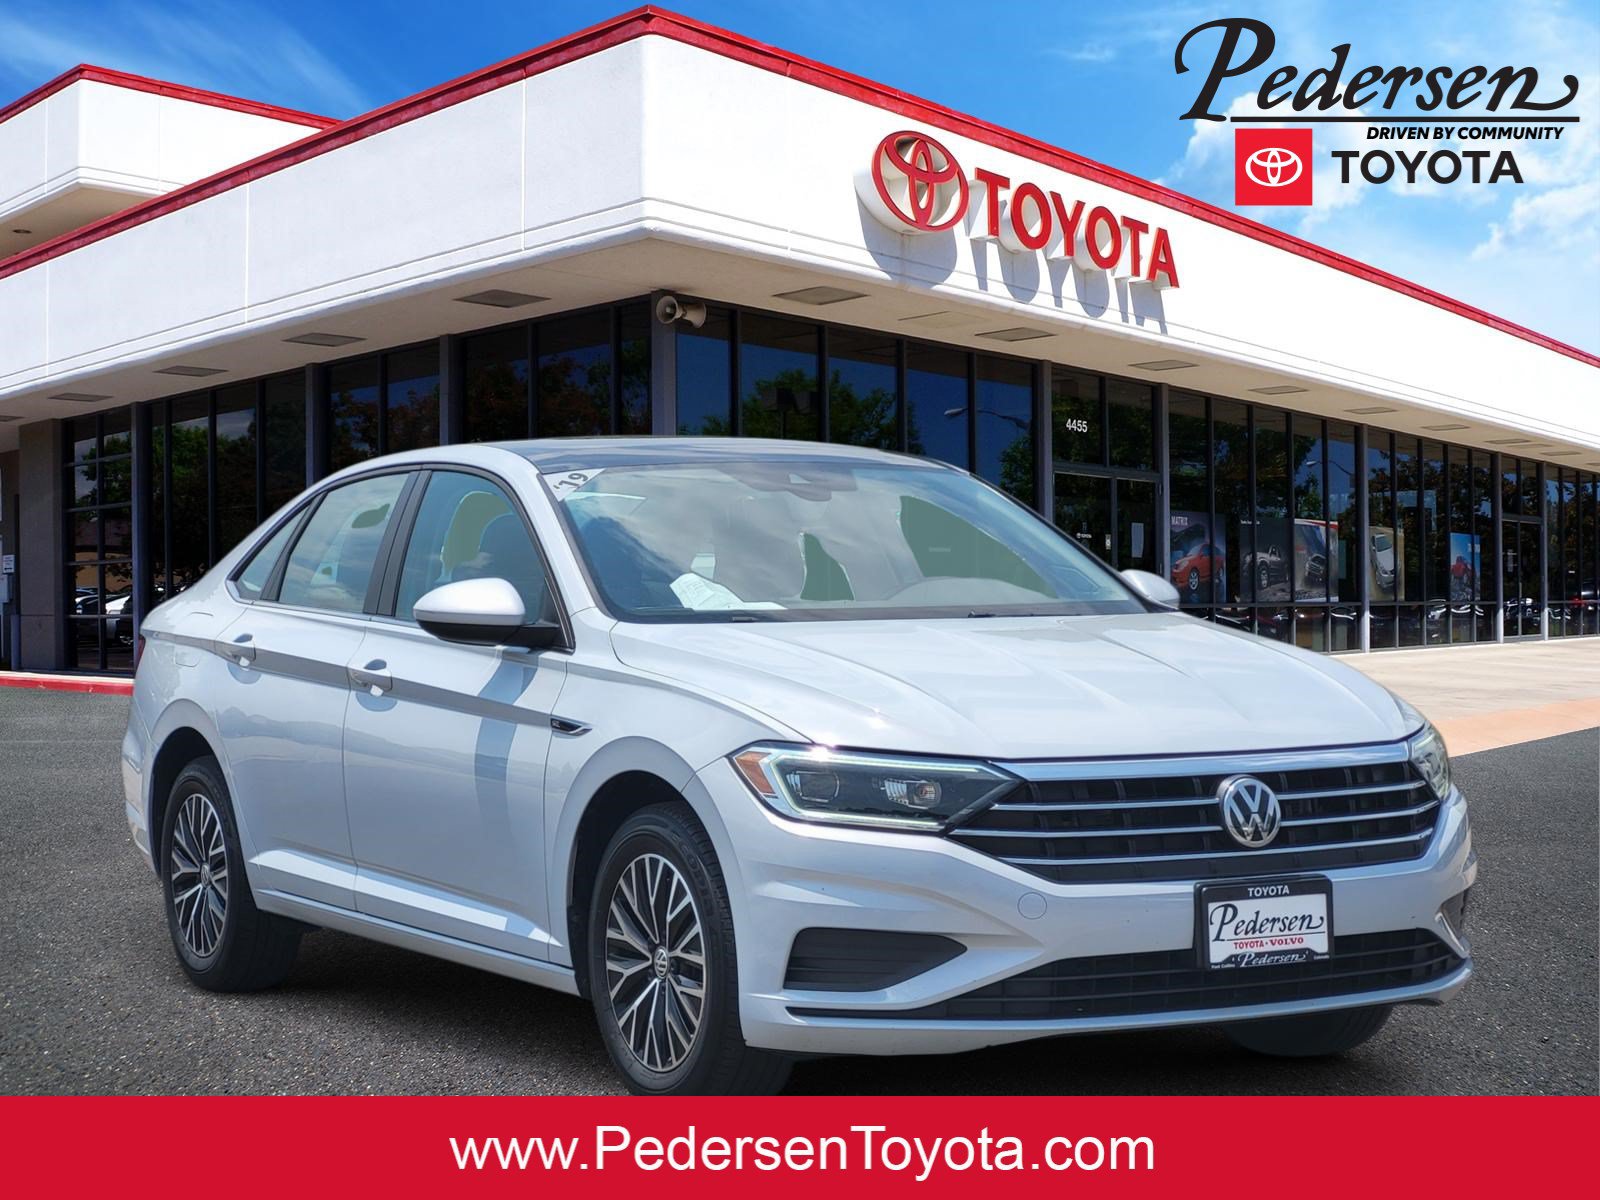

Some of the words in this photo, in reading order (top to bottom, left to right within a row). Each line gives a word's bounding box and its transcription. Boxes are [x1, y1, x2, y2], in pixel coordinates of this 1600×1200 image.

[974, 167, 1180, 289] TOYOTA
[1065, 418, 1089, 434] 4455
[1247, 884, 1290, 897] TOYOTA
[1209, 903, 1325, 942] Pedersen
[1233, 940, 1265, 950] TOYOTA
[1269, 936, 1305, 947] VOLVO
[1237, 951, 1307, 967] Pedersen
